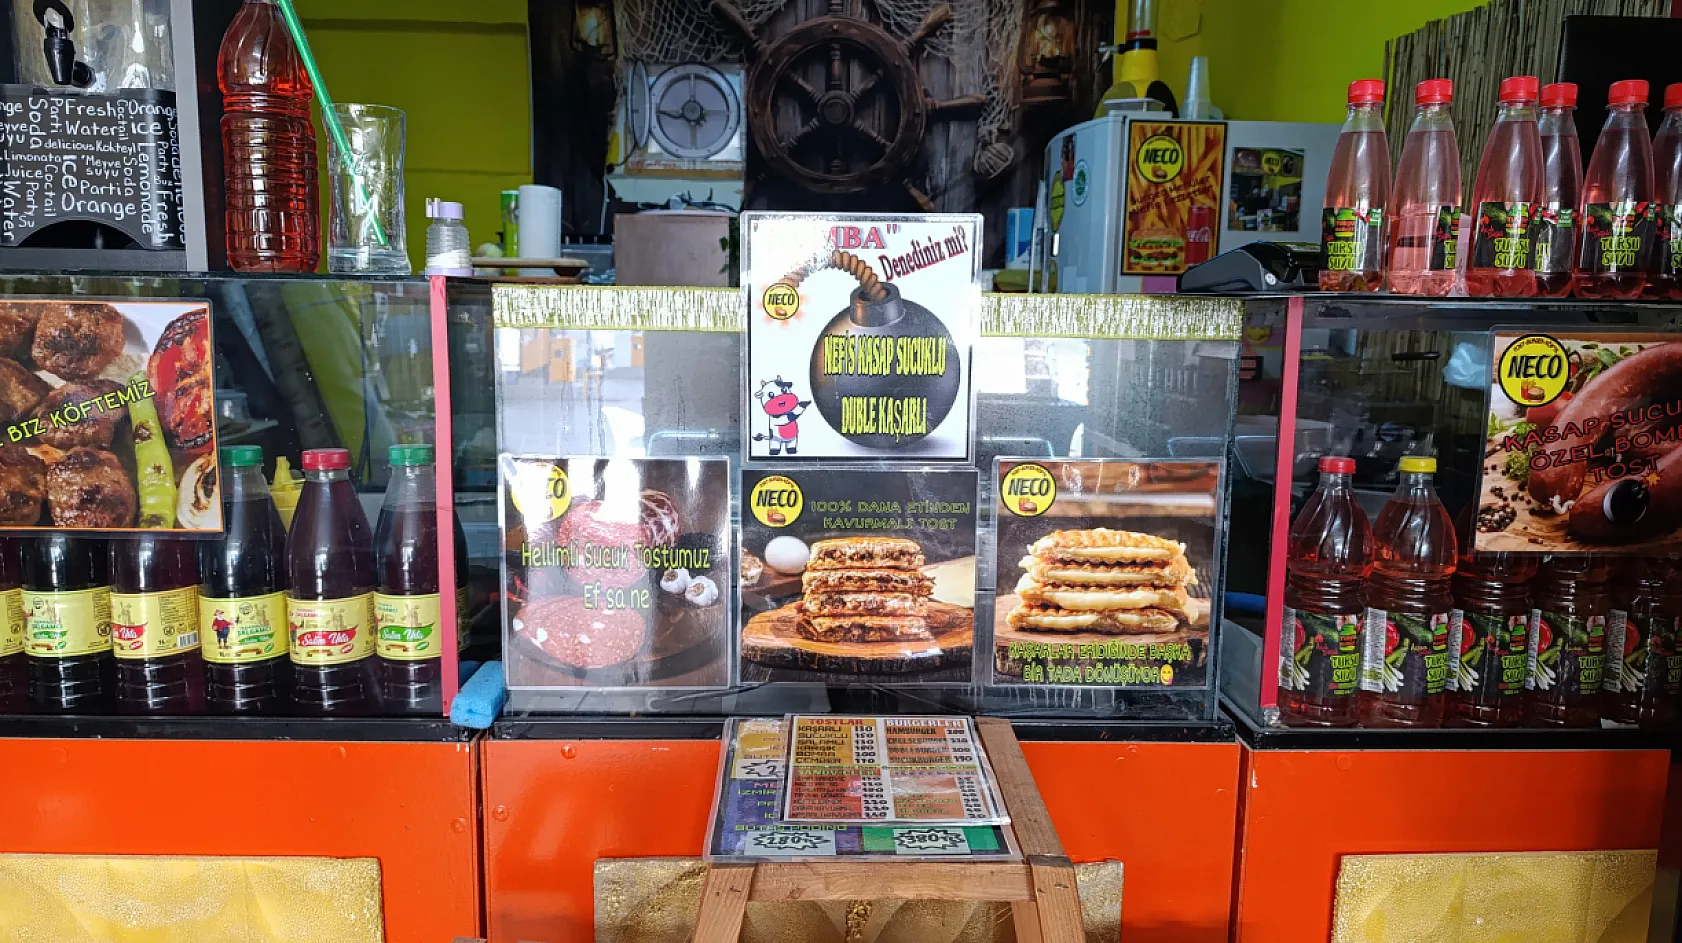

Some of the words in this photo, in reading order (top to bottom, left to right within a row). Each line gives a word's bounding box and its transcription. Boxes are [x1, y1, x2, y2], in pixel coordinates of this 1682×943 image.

[50, 97, 64, 133] Parti
[65, 98, 117, 117] Fresh
[28, 97, 49, 149] Soda
[65, 120, 118, 136] Water
[4, 149, 62, 163] Limonata
[44, 139, 95, 151] delicious
[1143, 147, 1180, 165] NECO
[157, 141, 169, 173] Party
[5, 163, 43, 178] Juice
[86, 168, 120, 179] suyu
[123, 156, 138, 197] Soda
[80, 180, 122, 196] Parti
[138, 142, 158, 235] Lemonade
[3, 181, 21, 241] Water
[61, 192, 137, 220] Orange
[155, 190, 175, 246] Fresh
[878, 236, 946, 282] Denediniz
[948, 224, 969, 259] mi?
[767, 293, 796, 306] NECO
[857, 336, 895, 376] KASAP
[896, 335, 947, 376] SUCUKLU
[1507, 355, 1562, 378] NECO
[50, 380, 156, 429] KÖFTEMİZ
[841, 396, 877, 435] DUBLE
[1503, 417, 1600, 453] KASAP
[1530, 443, 1604, 471] ÖZEL
[1589, 454, 1661, 484] TOST
[1008, 477, 1051, 497] NECO
[756, 490, 798, 507] NECO
[811, 500, 852, 514] 100%
[857, 501, 901, 514] DANA
[918, 517, 958, 530] TOST
[521, 541, 580, 568] Hellimli
[584, 542, 629, 569] Sucuk
[634, 543, 711, 569] Tostumuz
[630, 588, 650, 609] ne
[1047, 664, 1082, 683] TADA
[808, 718, 864, 726] TOSTLAR
[886, 719, 961, 727] BURGERLER
